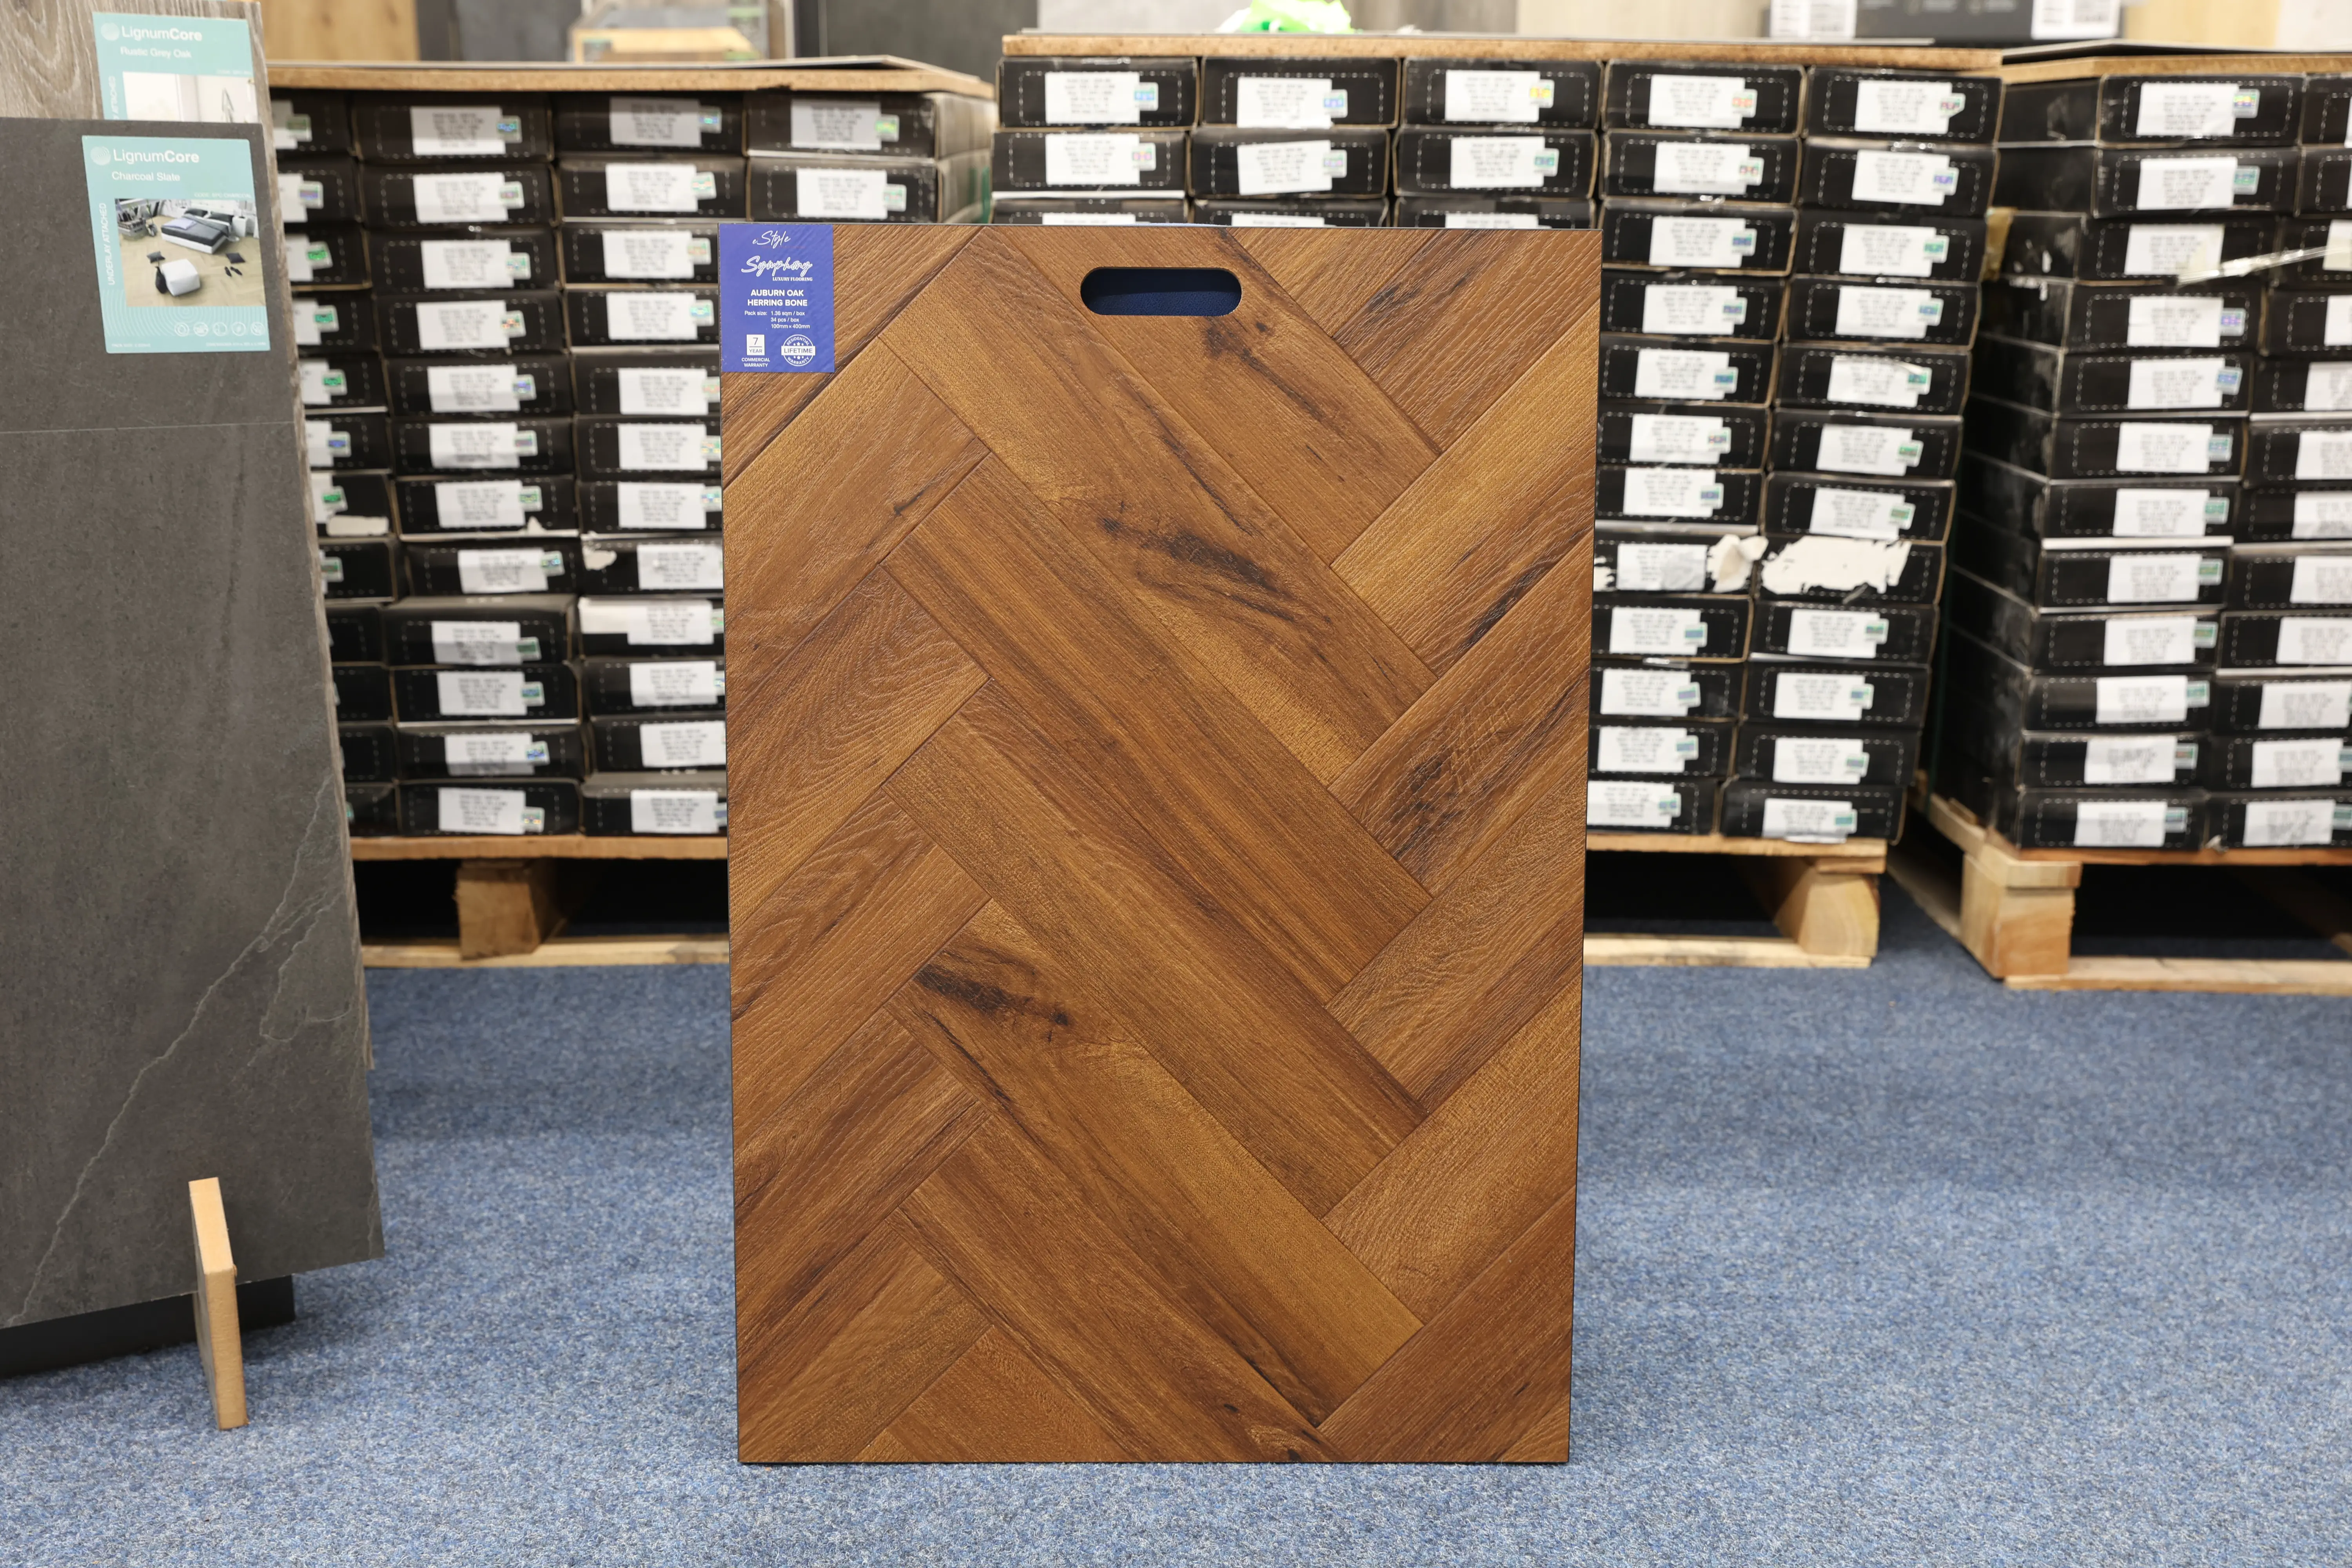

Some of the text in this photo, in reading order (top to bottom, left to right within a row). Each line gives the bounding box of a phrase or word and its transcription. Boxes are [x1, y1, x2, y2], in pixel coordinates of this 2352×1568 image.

[122, 25, 202, 41] LignumCore
[120, 46, 192, 59] Rustic Grey Oak
[113, 149, 200, 165] LignumCore
[112, 171, 181, 181] Charcoal Slate
[99, 203, 115, 285] UNDERLAY ATTACHED
[752, 230, 791, 249] eStyle
[741, 256, 813, 277] Symphony
[786, 336, 809, 346] RESIDENTIAL
[787, 356, 809, 365] WARRANTY
